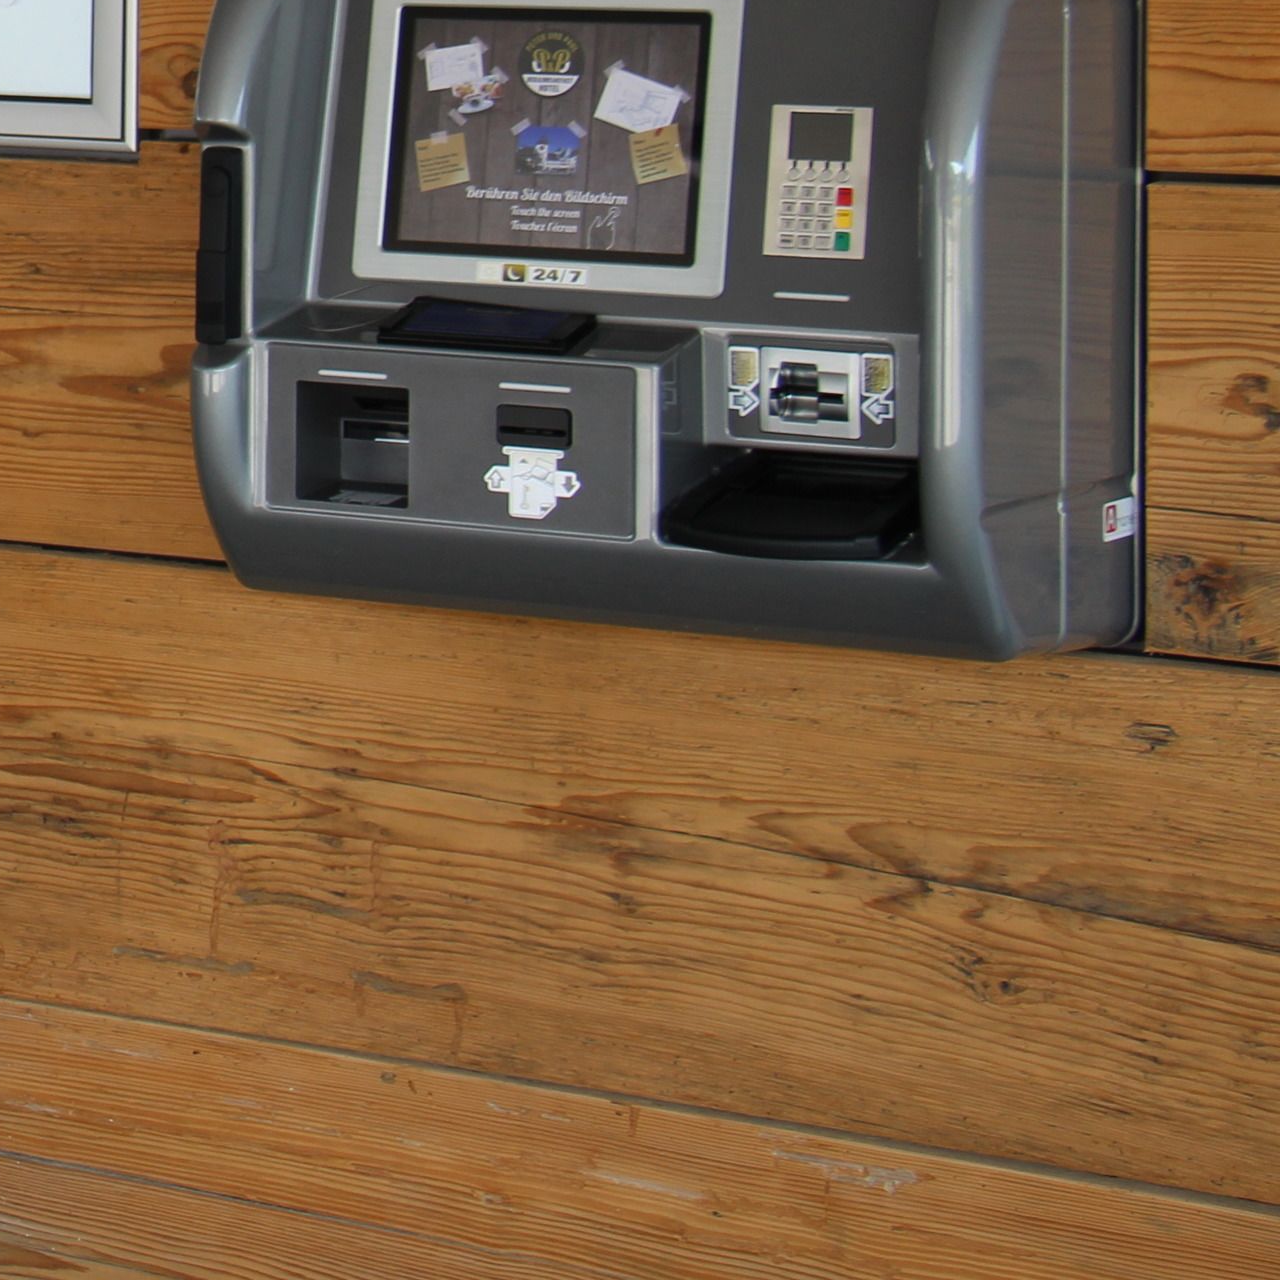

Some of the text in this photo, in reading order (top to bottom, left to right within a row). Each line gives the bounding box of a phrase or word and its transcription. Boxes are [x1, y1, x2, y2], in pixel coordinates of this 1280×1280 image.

[465, 185, 628, 205] Berühren Sie den Bildschirm
[532, 268, 582, 283] 24/7
